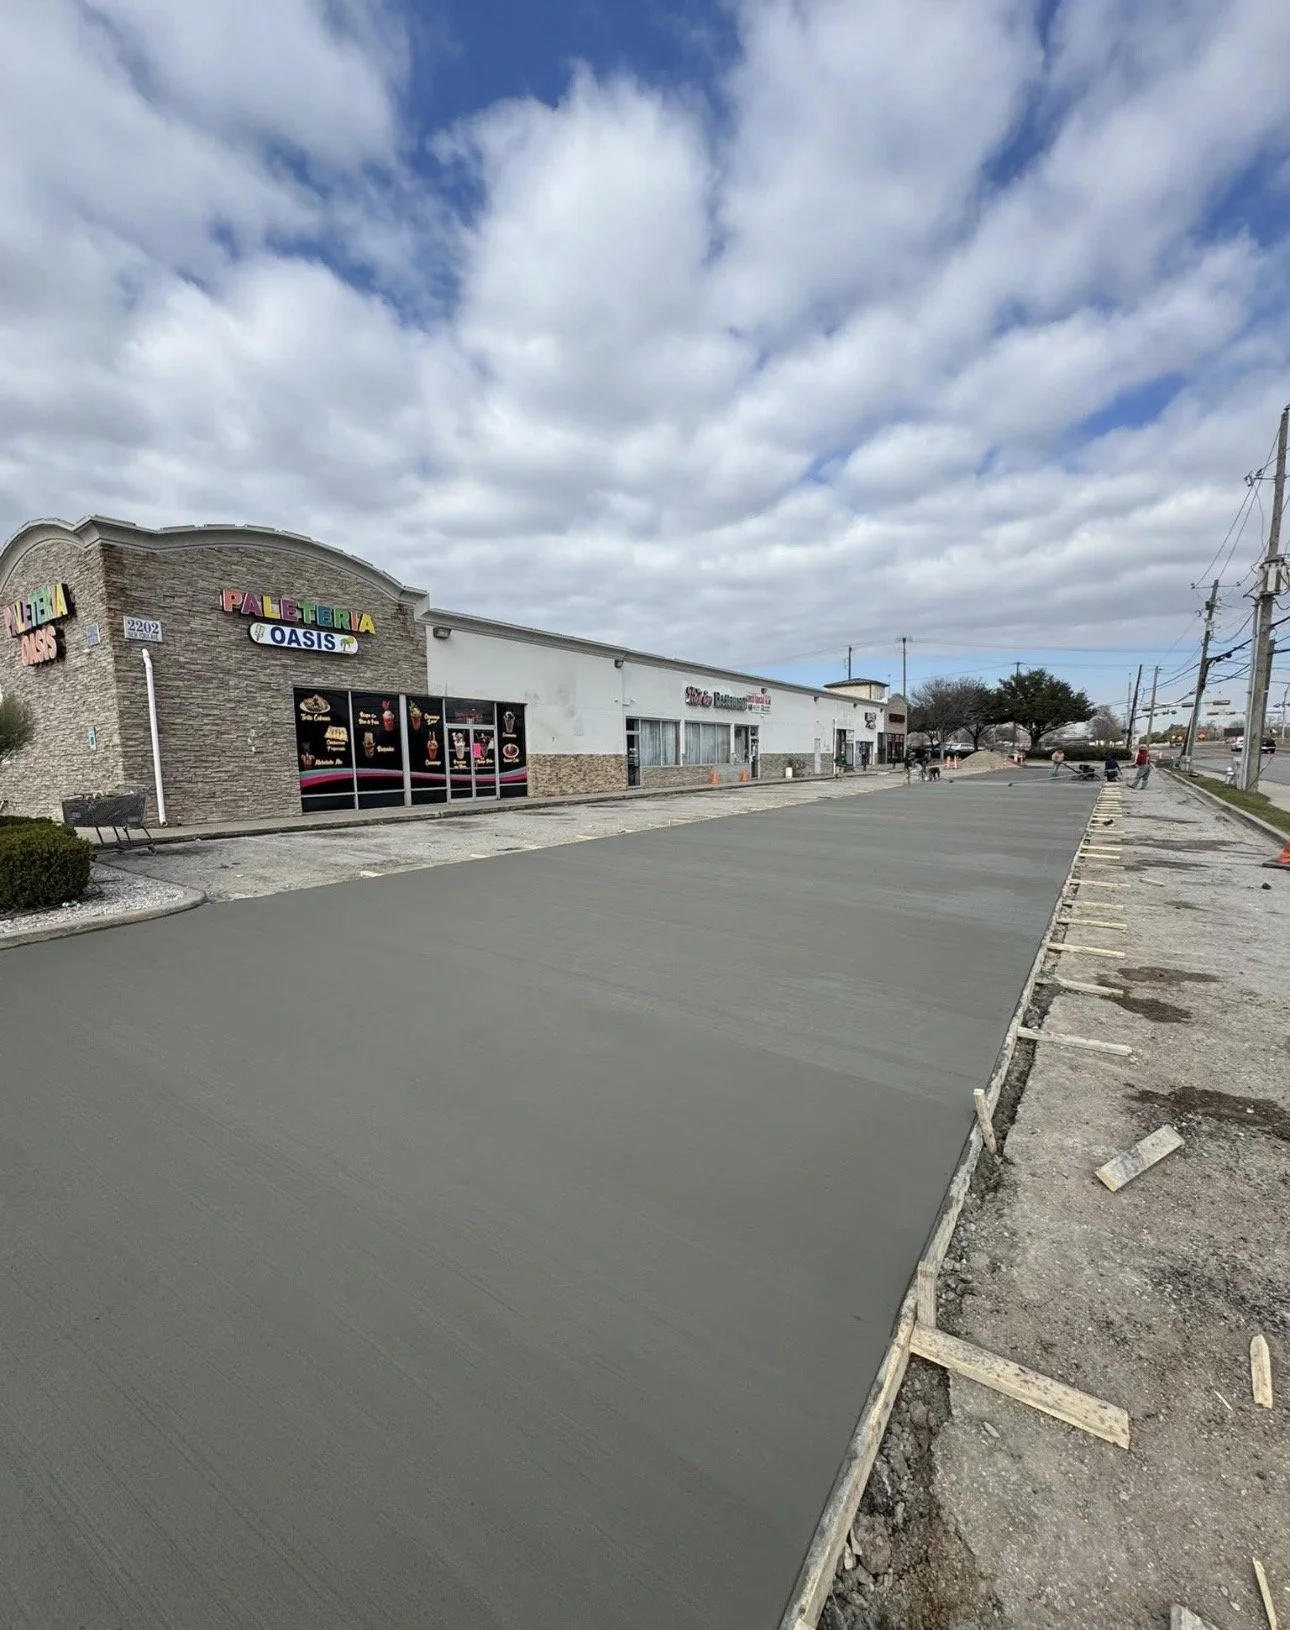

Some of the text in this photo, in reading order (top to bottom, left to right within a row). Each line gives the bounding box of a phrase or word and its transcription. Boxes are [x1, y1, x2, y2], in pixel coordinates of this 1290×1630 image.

[222, 588, 376, 635] PALETERIA
[127, 619, 159, 634] 2202
[270, 626, 336, 650] OASIS
